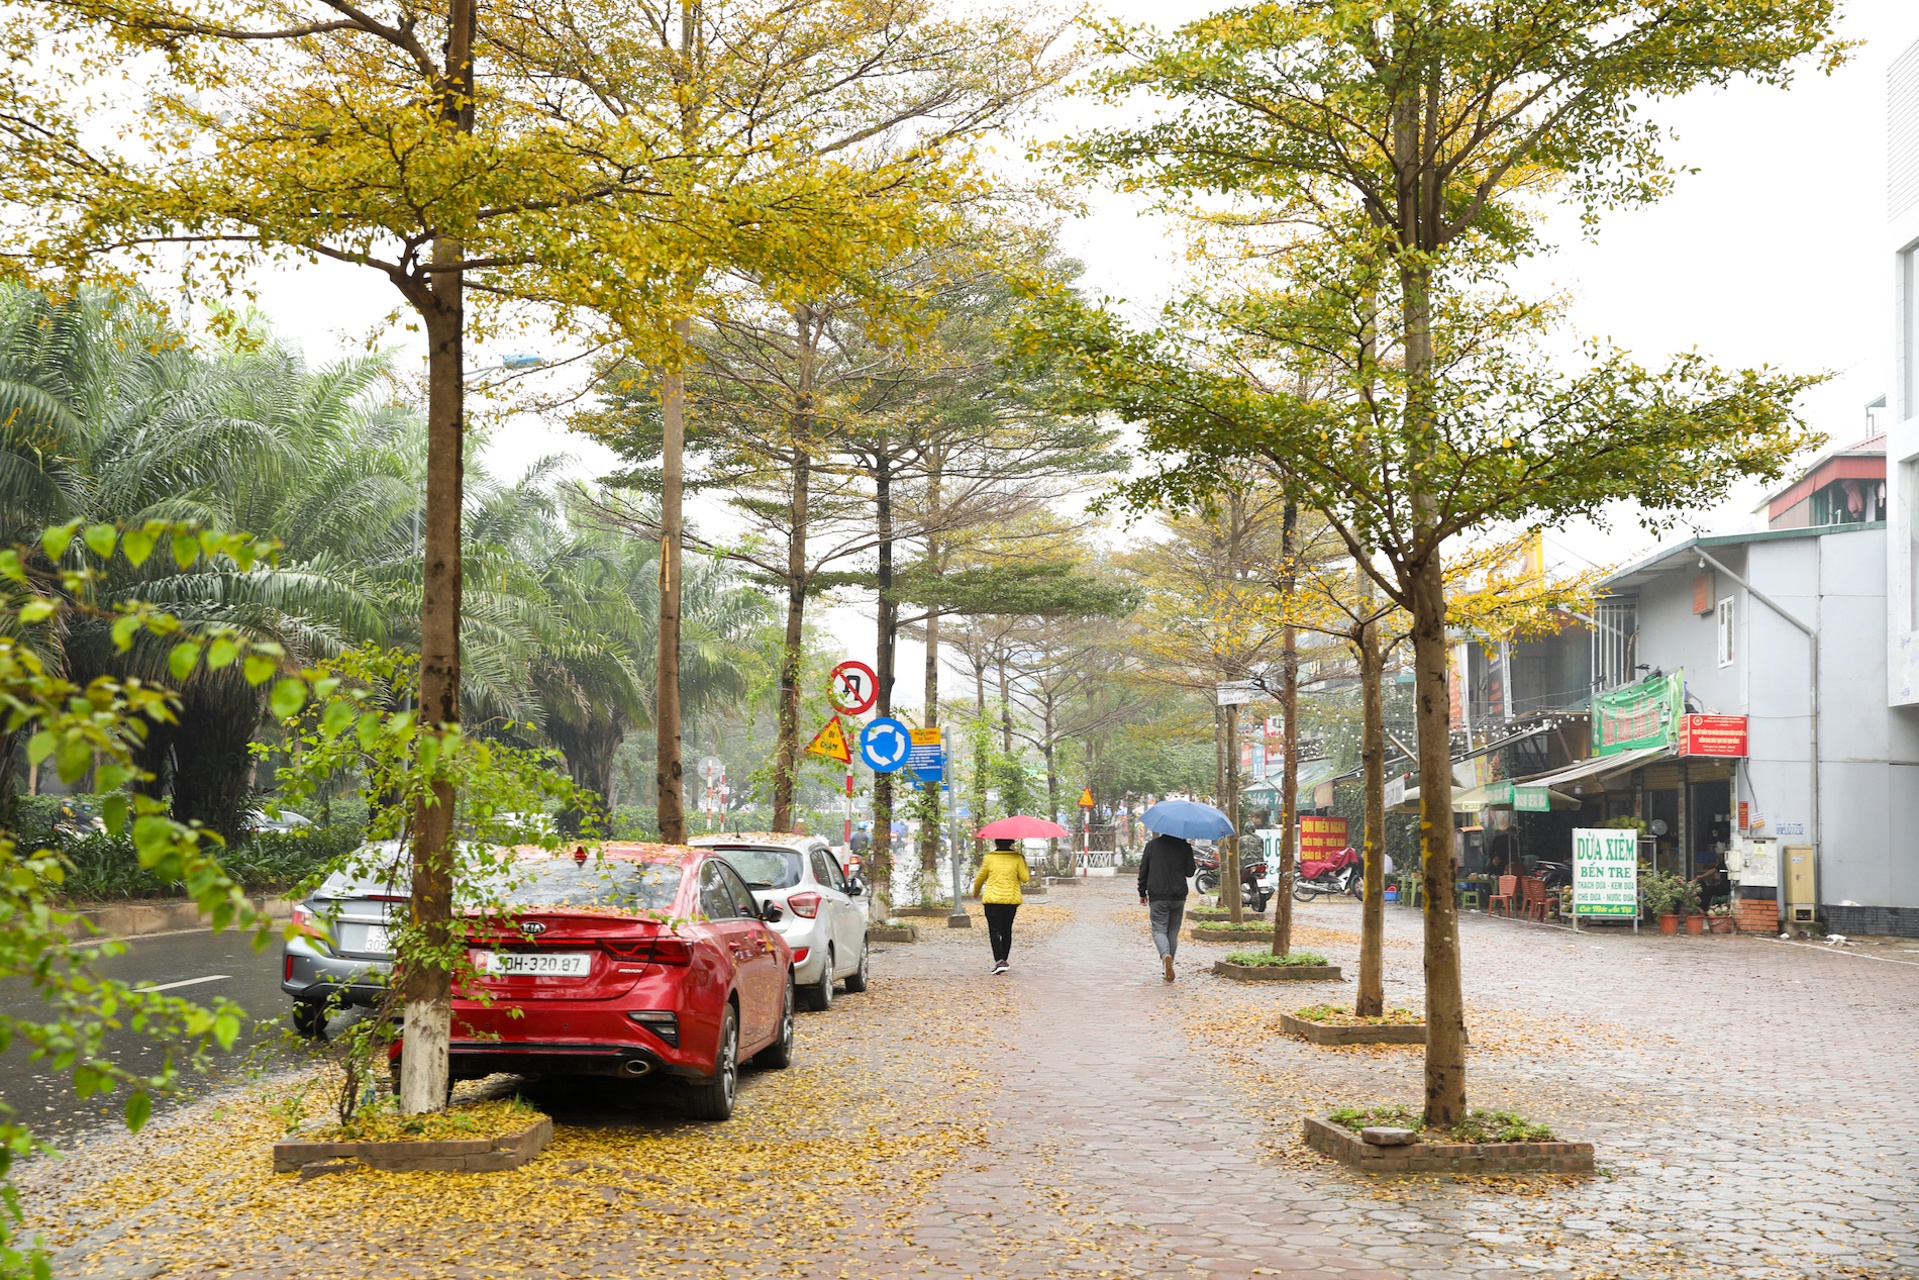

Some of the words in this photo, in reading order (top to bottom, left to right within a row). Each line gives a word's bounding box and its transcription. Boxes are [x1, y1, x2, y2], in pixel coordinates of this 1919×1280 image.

[1577, 832, 1602, 860] DỪA
[1606, 832, 1634, 861] XIÊM
[1580, 862, 1604, 877] BẾN
[1608, 867, 1631, 878] TRE
[523, 923, 540, 932] KIA
